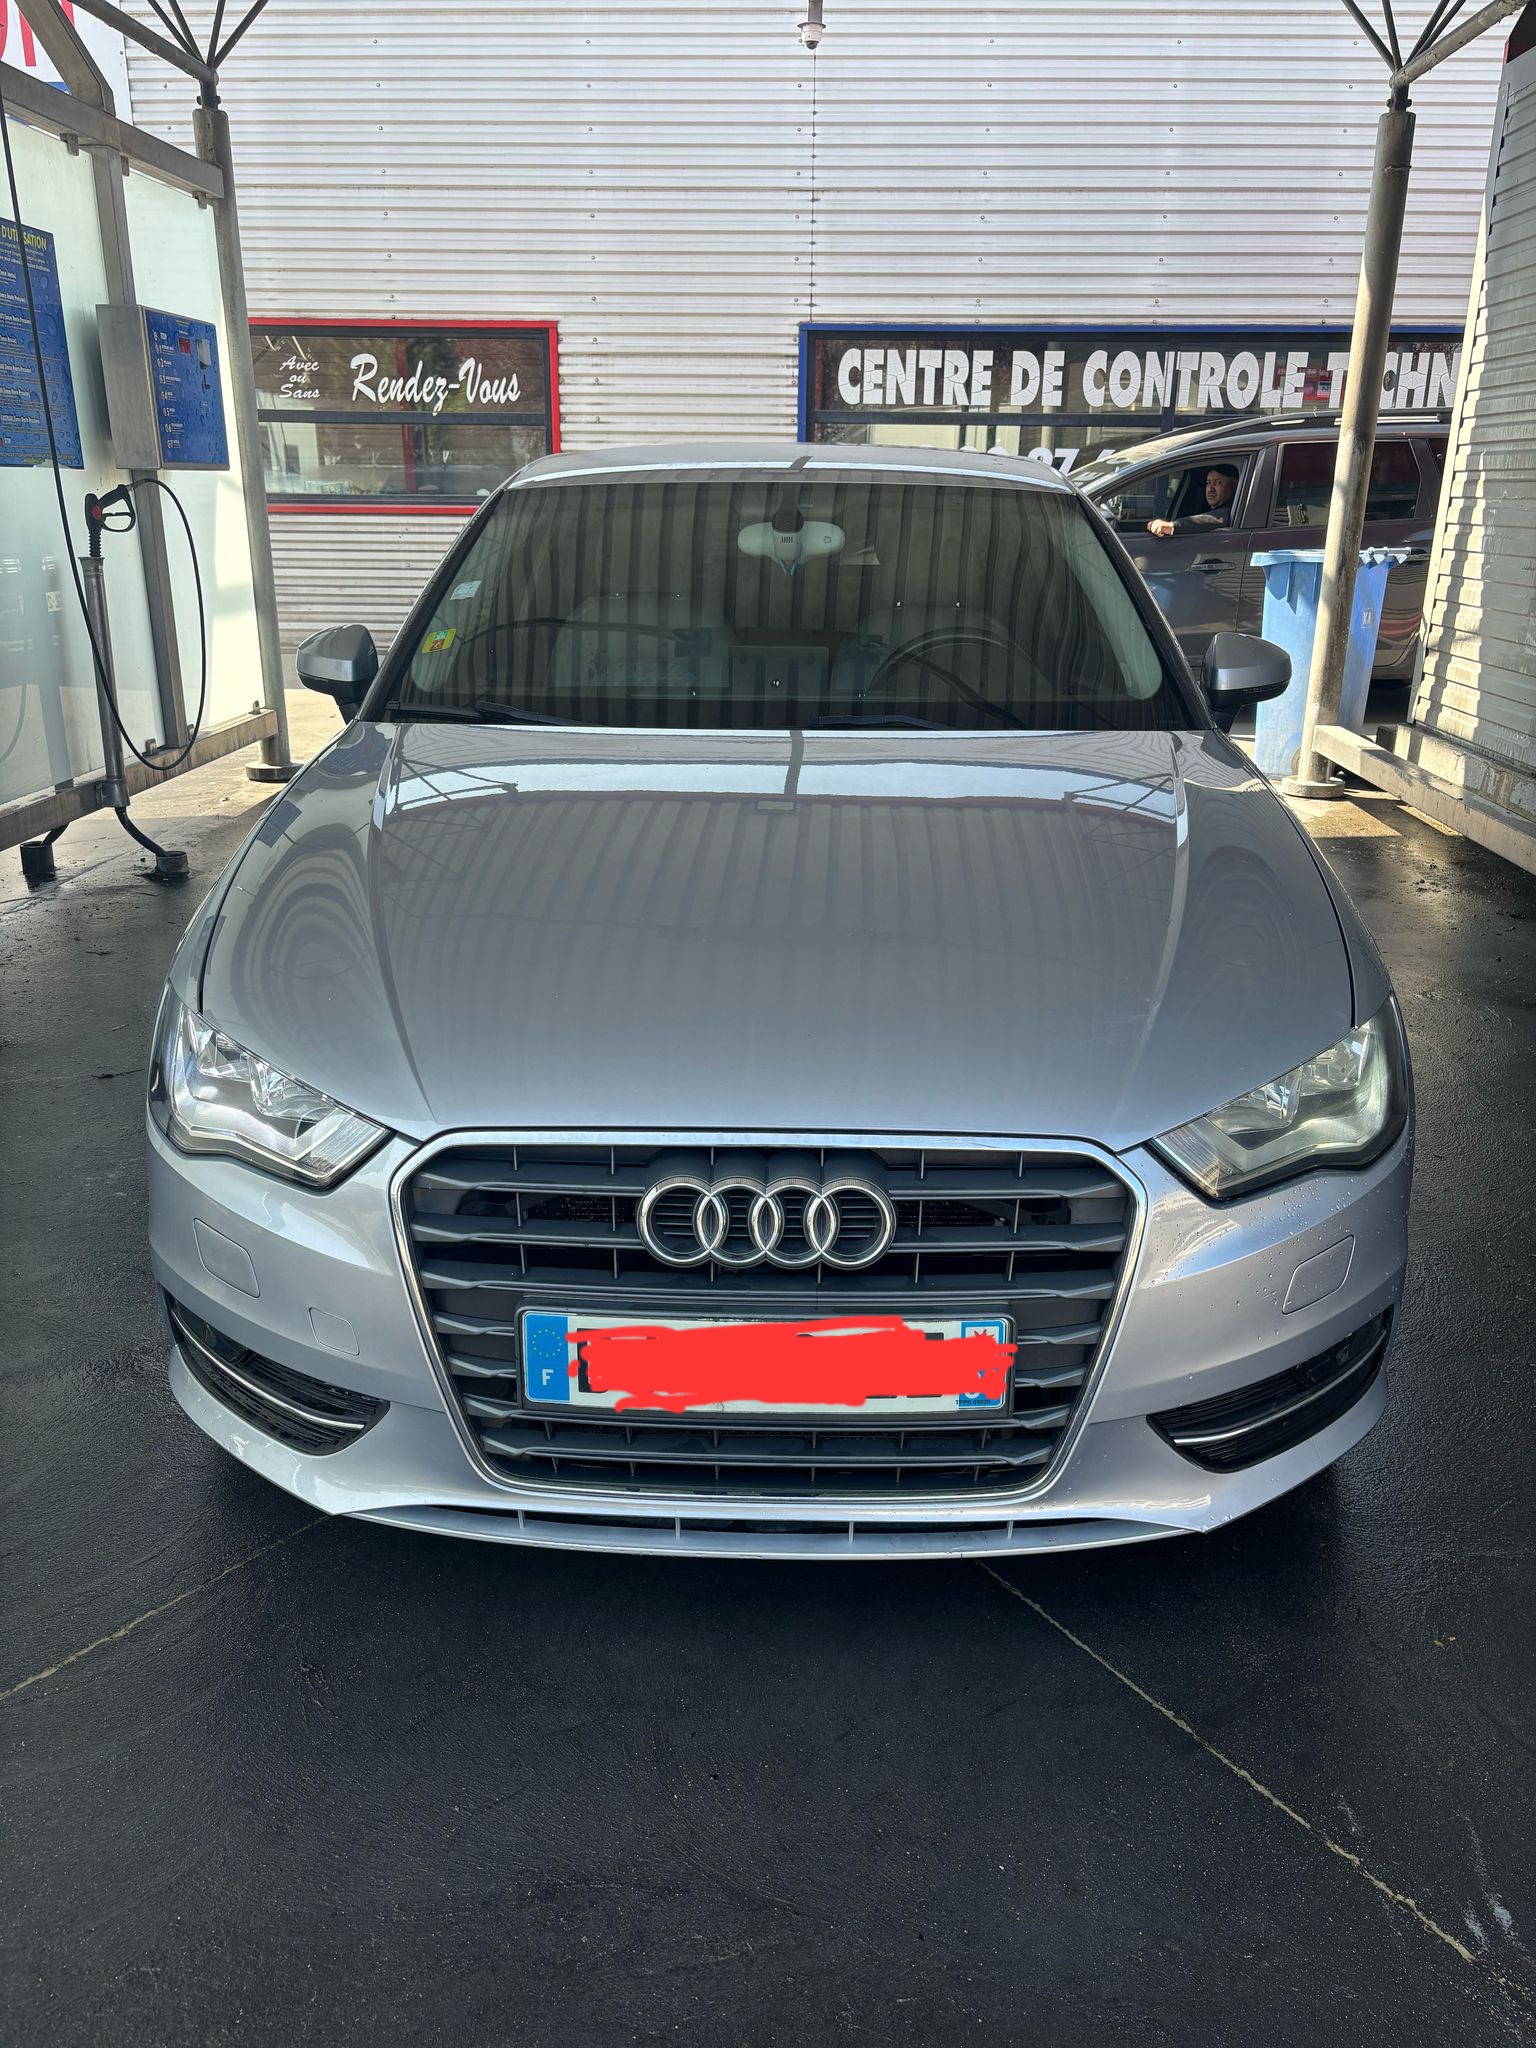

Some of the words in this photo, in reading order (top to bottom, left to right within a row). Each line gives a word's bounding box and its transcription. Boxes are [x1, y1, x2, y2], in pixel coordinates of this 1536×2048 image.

[1, 225, 47, 250] D'UTISATION
[280, 355, 320, 371] Avec
[290, 374, 307, 384] ou
[350, 353, 521, 416] Rendez-Vous
[838, 348, 994, 406] CENTRE
[1010, 350, 1066, 407] DE
[1082, 350, 1309, 409] CONTROLE
[1327, 351, 1461, 409] TCHN
[279, 383, 321, 399] Sans
[542, 1368, 554, 1386] F
